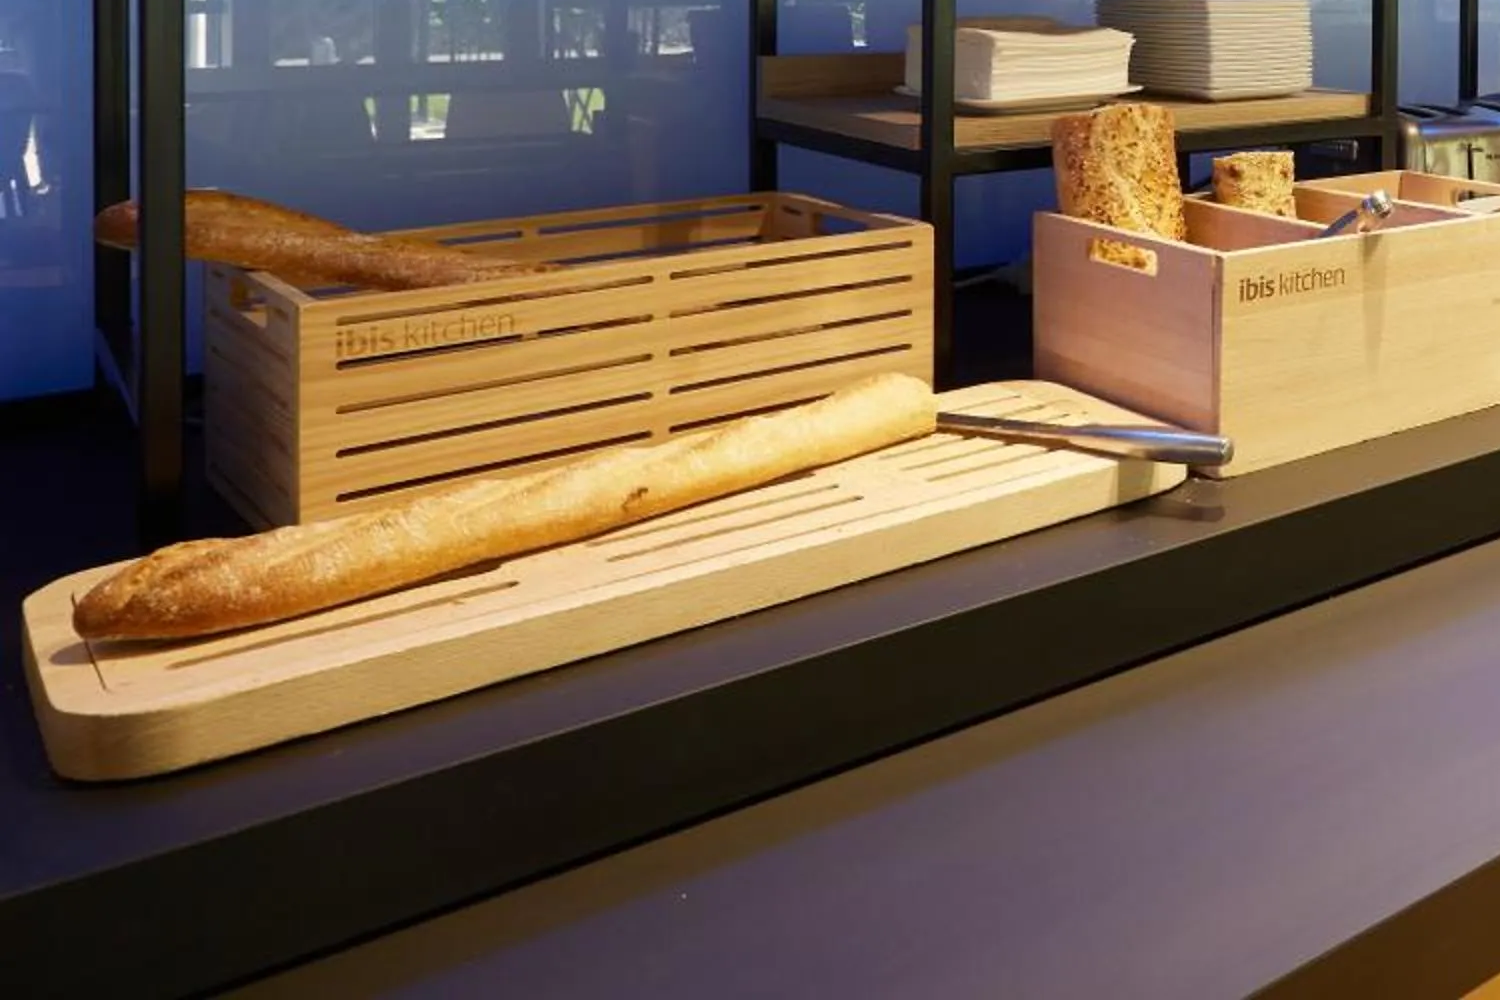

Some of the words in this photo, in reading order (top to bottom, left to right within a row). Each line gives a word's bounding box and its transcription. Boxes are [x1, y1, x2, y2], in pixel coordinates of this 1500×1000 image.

[1238, 276, 1275, 303] ibis
[1279, 267, 1346, 297] kitchen
[335, 325, 396, 357] ibis
[403, 312, 516, 349] kitchen
